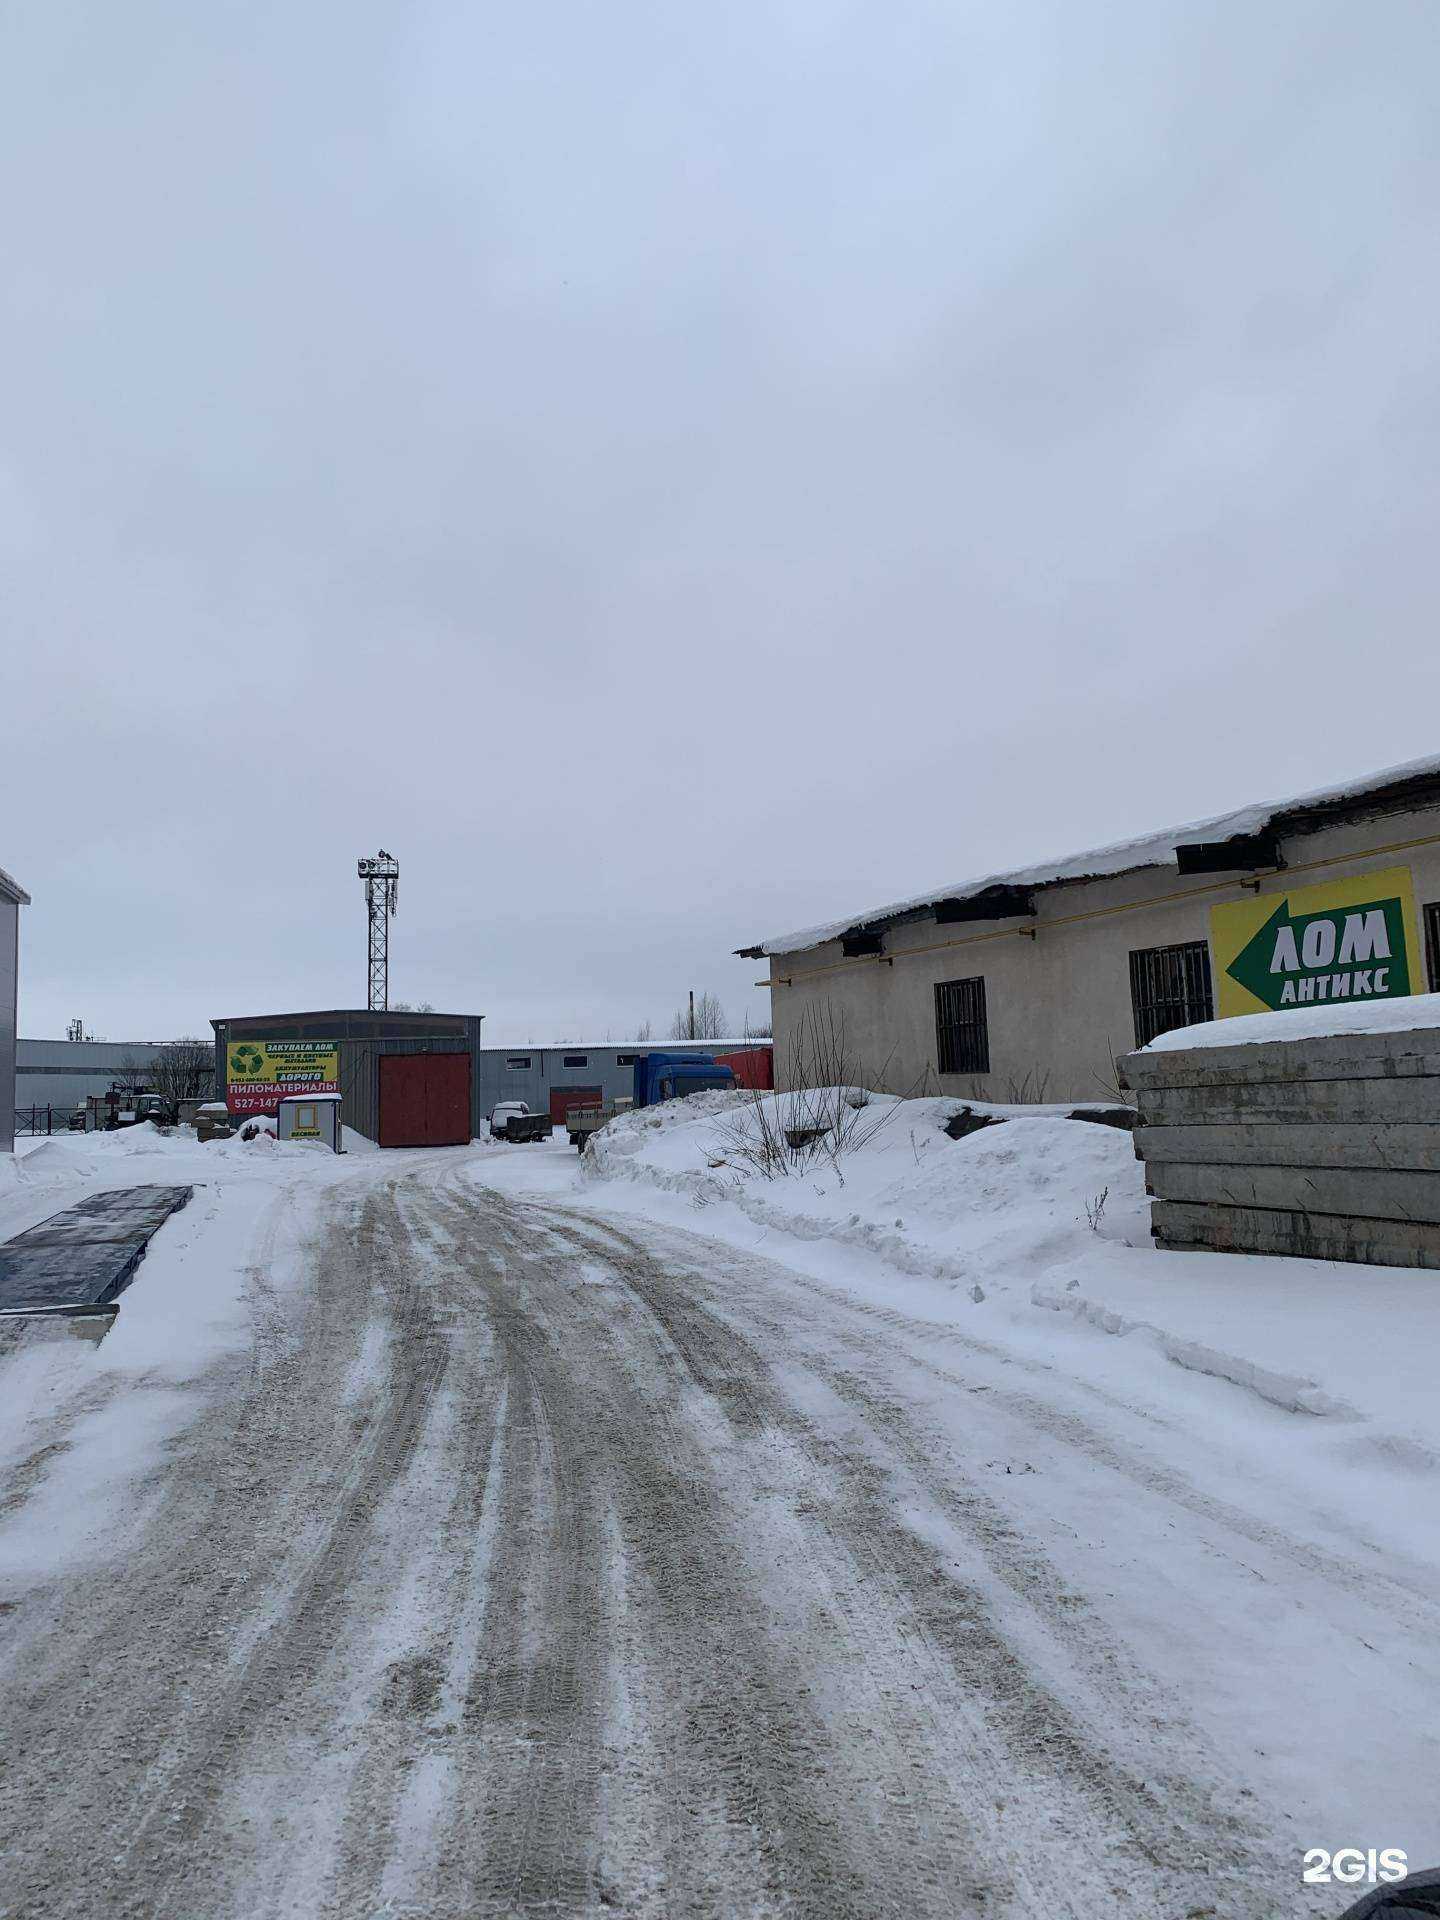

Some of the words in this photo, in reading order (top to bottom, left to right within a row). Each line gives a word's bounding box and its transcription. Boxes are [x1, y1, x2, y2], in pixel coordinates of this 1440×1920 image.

[1270, 909, 1393, 974] ЛОМ
[1280, 967, 1390, 1004] АНТИКС
[267, 1043, 313, 1052] ЗАКУПАЕМ
[315, 1043, 334, 1051] ЛОМ
[279, 1073, 321, 1081] ДОРОГО
[230, 1082, 337, 1094] ПИЛОМАТЕРИАЛЫ
[234, 1097, 279, 1109] 527-147
